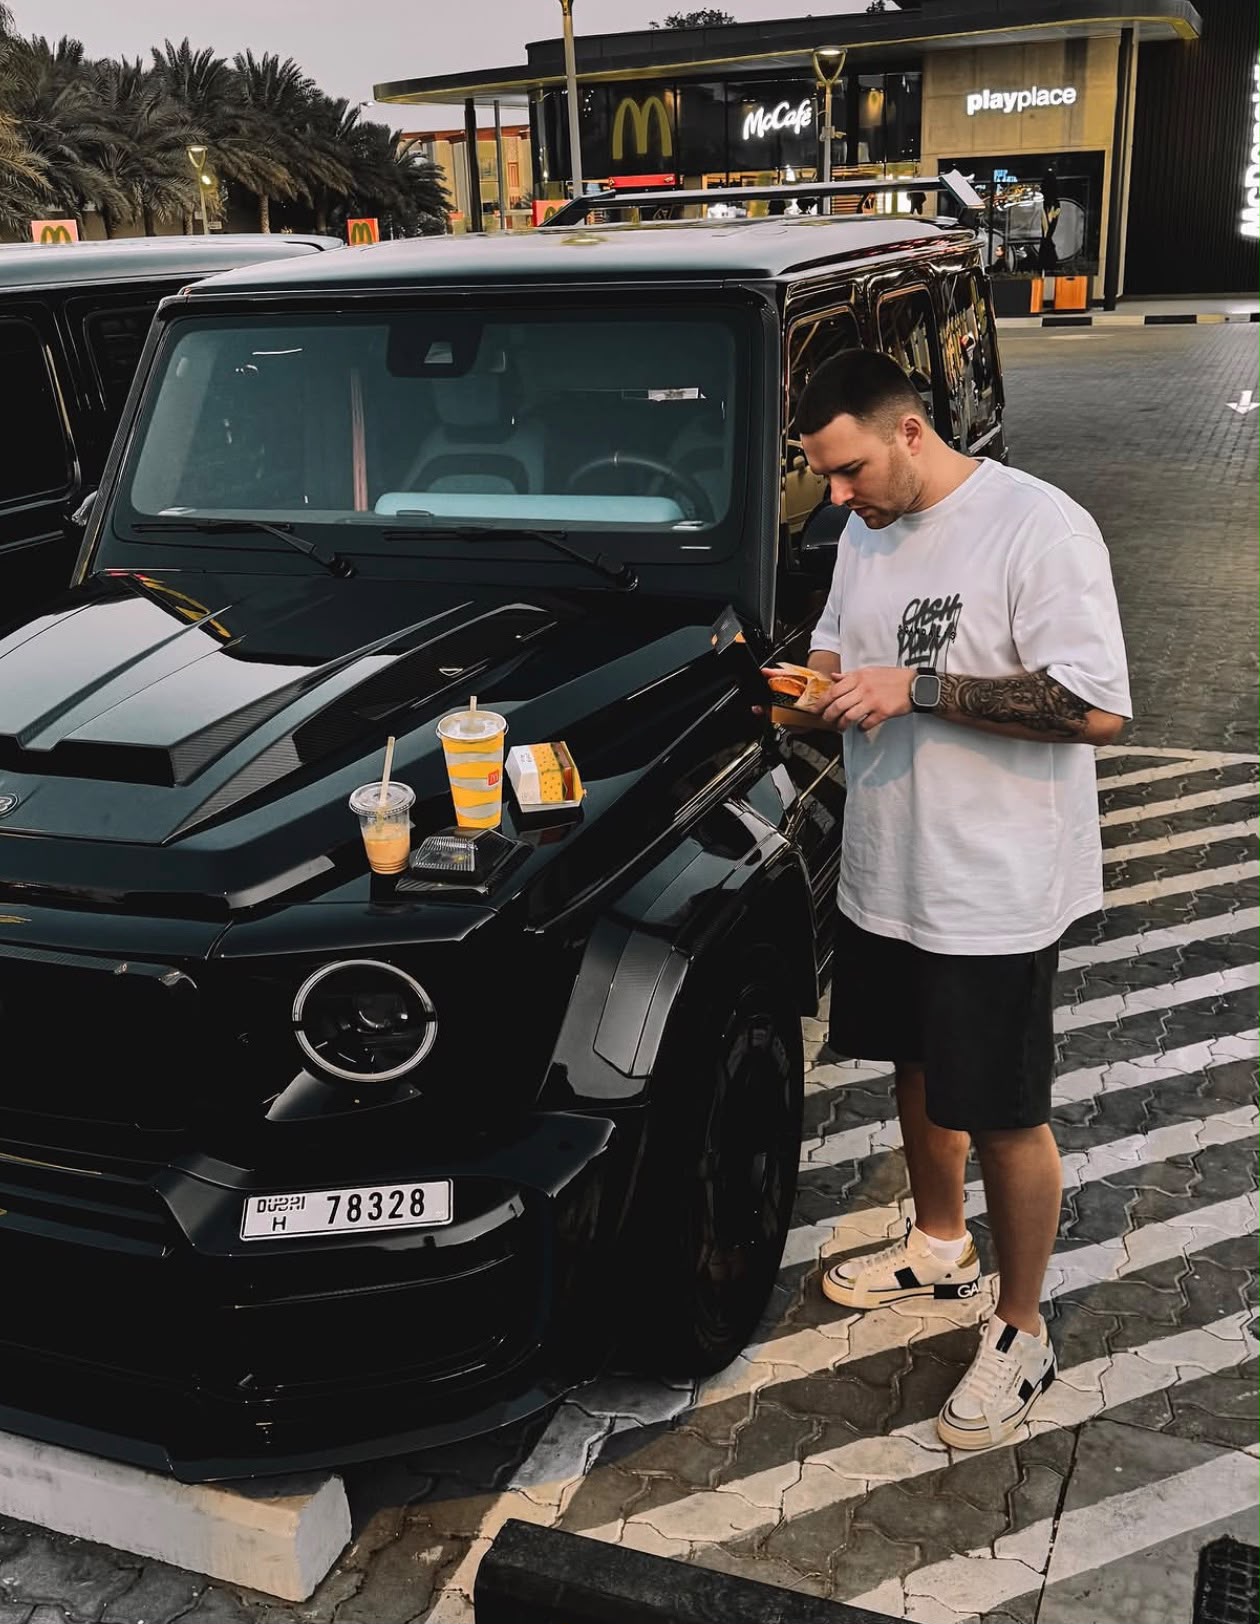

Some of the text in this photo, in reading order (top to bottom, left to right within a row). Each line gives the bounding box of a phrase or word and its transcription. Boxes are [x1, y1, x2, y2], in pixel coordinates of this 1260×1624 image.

[966, 86, 1077, 115] playplace
[326, 1188, 425, 1225] 78328
[272, 1216, 287, 1232] H
